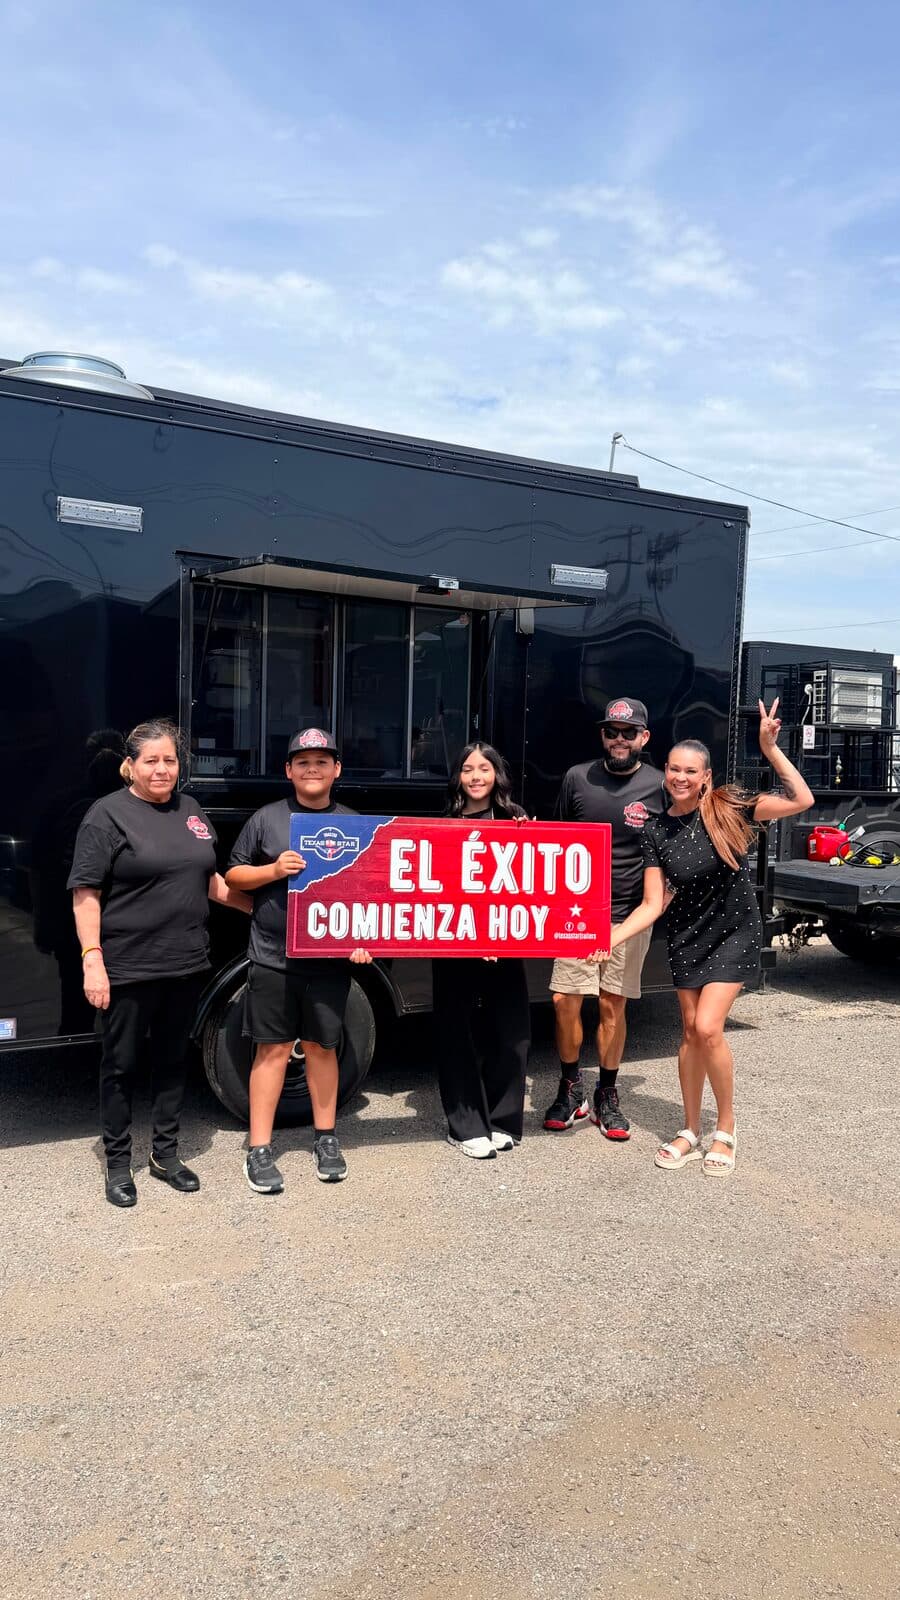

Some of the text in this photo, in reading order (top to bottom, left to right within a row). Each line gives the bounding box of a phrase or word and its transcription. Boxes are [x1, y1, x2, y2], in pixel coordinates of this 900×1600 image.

[389, 830, 592, 895] EL ÉXITO
[307, 901, 550, 941] COMIENZA HOY
